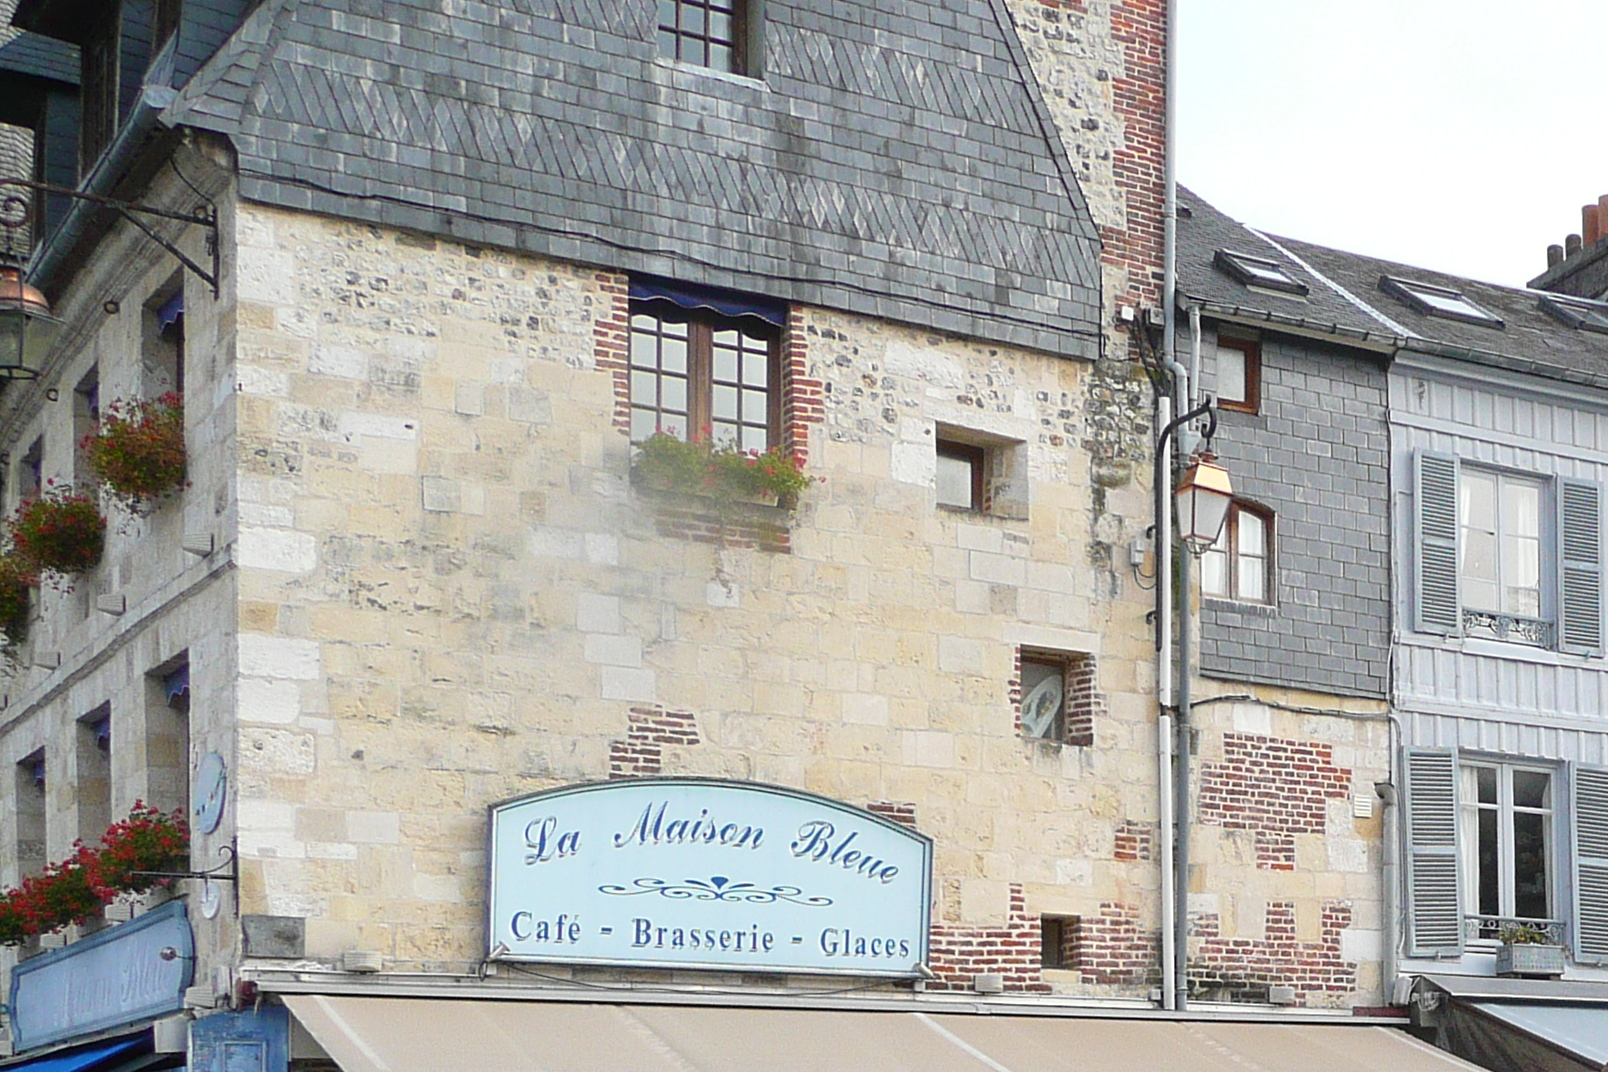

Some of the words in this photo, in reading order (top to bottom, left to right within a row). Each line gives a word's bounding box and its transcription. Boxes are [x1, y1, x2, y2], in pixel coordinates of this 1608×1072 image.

[524, 815, 582, 866] La
[613, 801, 764, 849] Maison
[791, 819, 900, 884] Bleue
[511, 910, 582, 944] Café
[631, 917, 775, 952] Brasserie
[820, 927, 910, 958] Glaces
